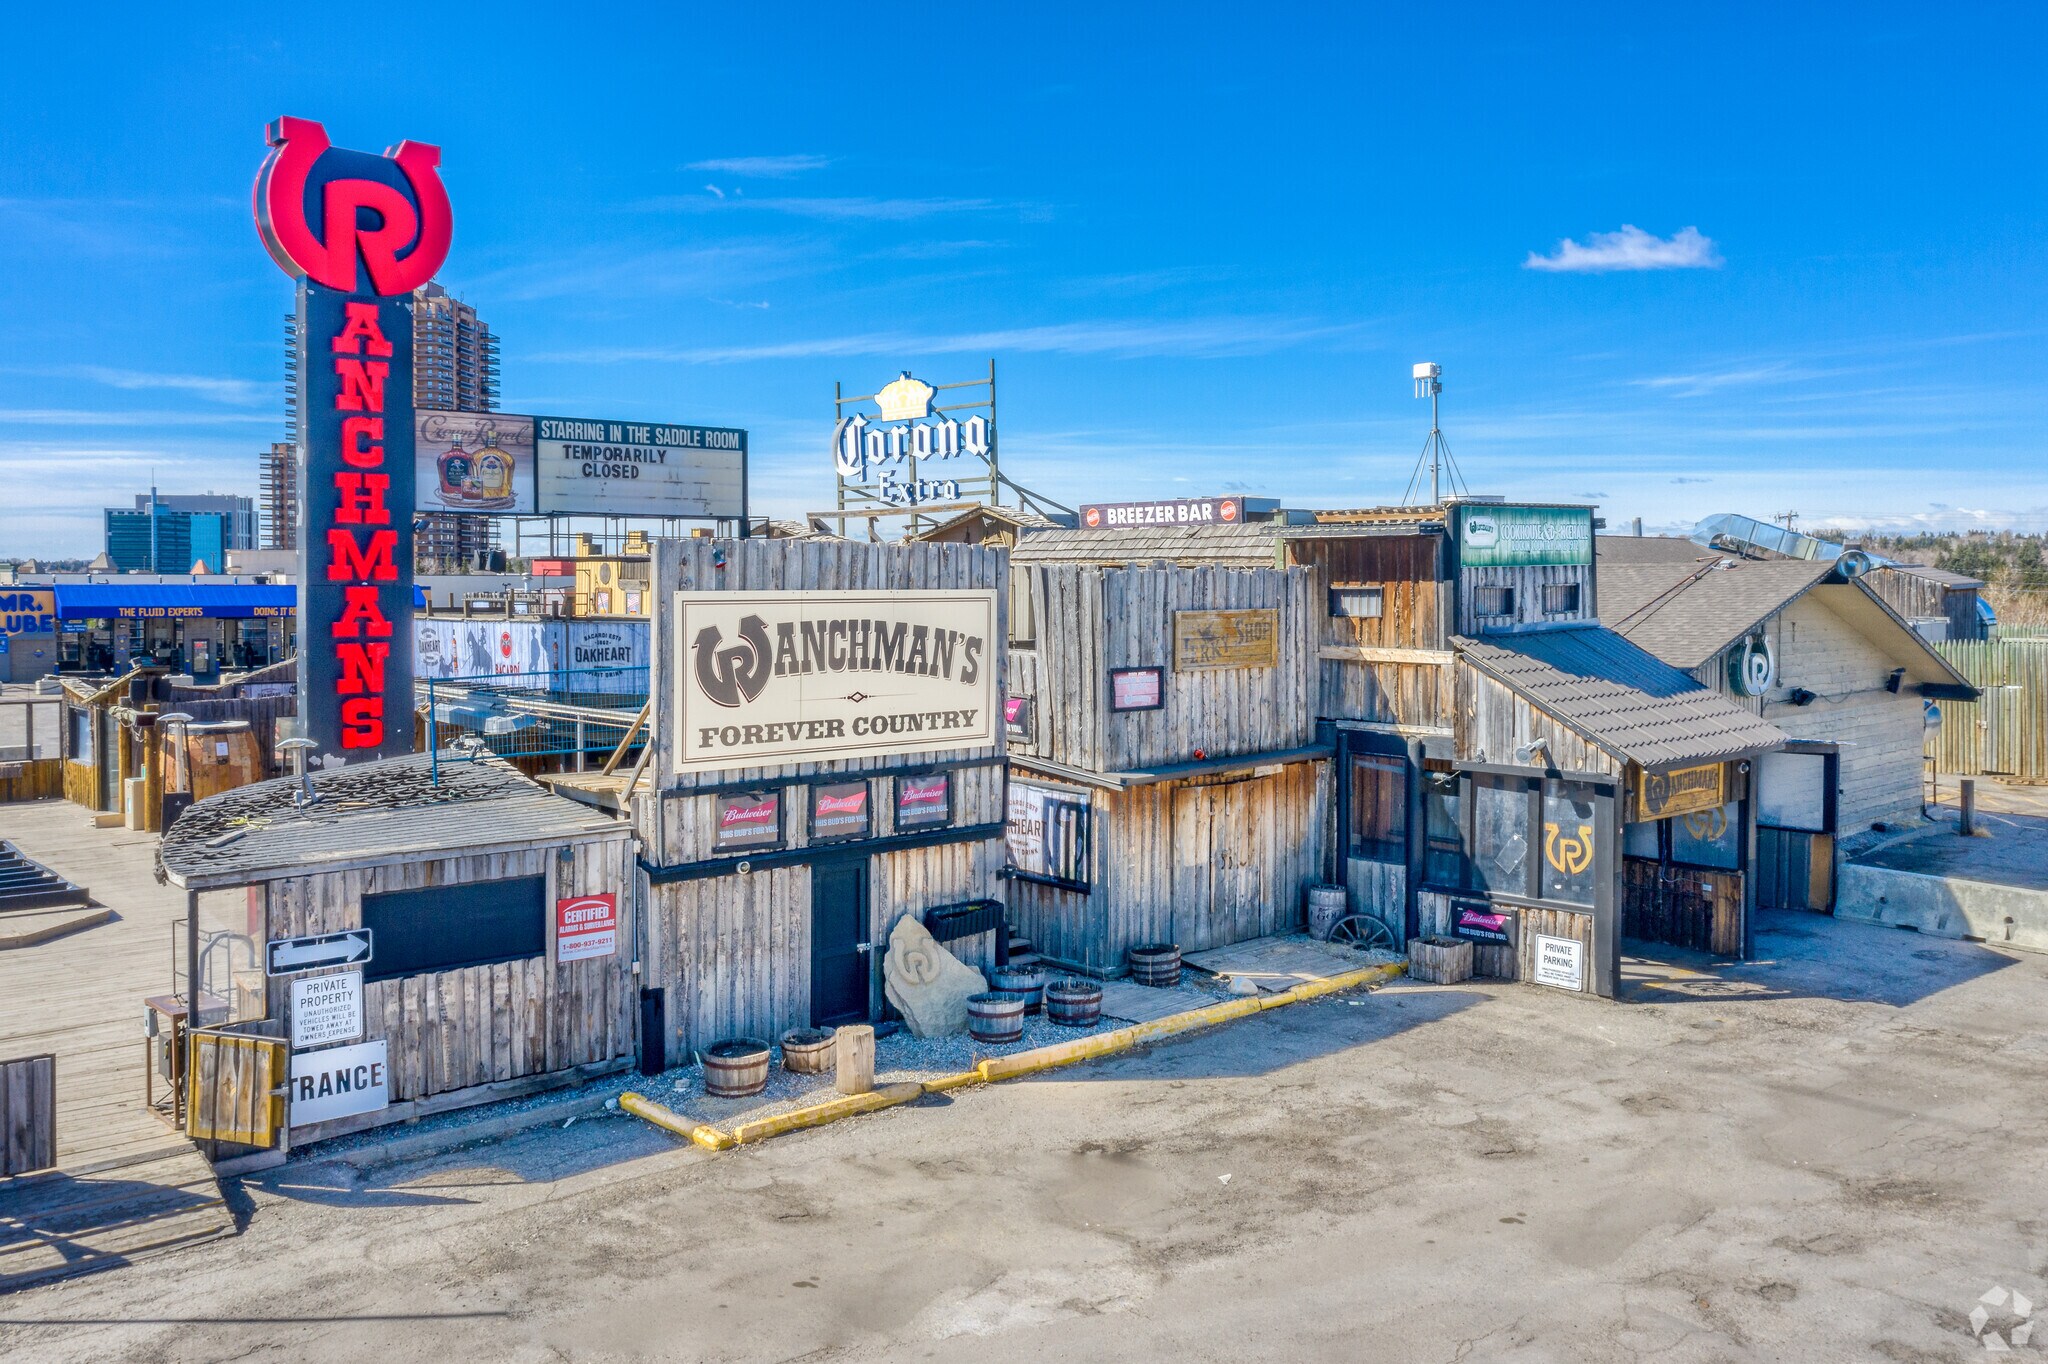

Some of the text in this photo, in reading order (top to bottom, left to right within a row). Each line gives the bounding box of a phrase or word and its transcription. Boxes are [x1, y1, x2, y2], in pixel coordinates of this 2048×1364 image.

[421, 415, 473, 444] Crown
[541, 420, 739, 449] STARRING IN THE SADDLE ROOM
[562, 444, 667, 464] TEMPORARILY
[832, 412, 992, 482] Corona
[582, 463, 639, 479] CLOSED
[878, 470, 962, 503] Extra
[1107, 505, 1175, 525] BREEZER
[1177, 503, 1212, 522] BAR
[0, 594, 43, 612] MR.
[119, 607, 136, 617] THE
[138, 607, 165, 617] FLUID
[168, 607, 203, 617] EXPERTS
[253, 607, 278, 616] DOING
[279, 607, 287, 616] IT
[1234, 617, 1271, 646] SHOP
[575, 646, 631, 663] OAKHEART
[691, 613, 984, 708] RANCHMAN'S
[699, 709, 978, 748] FOREVER COUNTRY
[902, 789, 944, 801] Budweiser
[819, 797, 863, 811] Budweiser
[724, 808, 773, 821] Budweiser
[828, 816, 845, 826] BUD'S
[845, 815, 856, 824] FOR
[719, 825, 779, 839] THIS BUD'S FOR YOU.
[565, 906, 609, 924] CERTIFIED
[1462, 912, 1503, 925] Budweiser
[1470, 928, 1485, 937] BUD'S
[1485, 931, 1495, 939] FOR
[1545, 943, 1573, 956] PRIVATE
[1543, 955, 1573, 968] PARKING
[306, 979, 348, 995] PRIVATE
[300, 990, 353, 1009] PROPERTY
[303, 1004, 352, 1018] UNAUTHORIZED
[300, 1015, 330, 1026] VEHICLES
[331, 1013, 346, 1021] WILL
[303, 1024, 324, 1033] TOWED
[326, 1021, 343, 1030] AWAY
[300, 1026, 356, 1041] OWNERS EXPENSE
